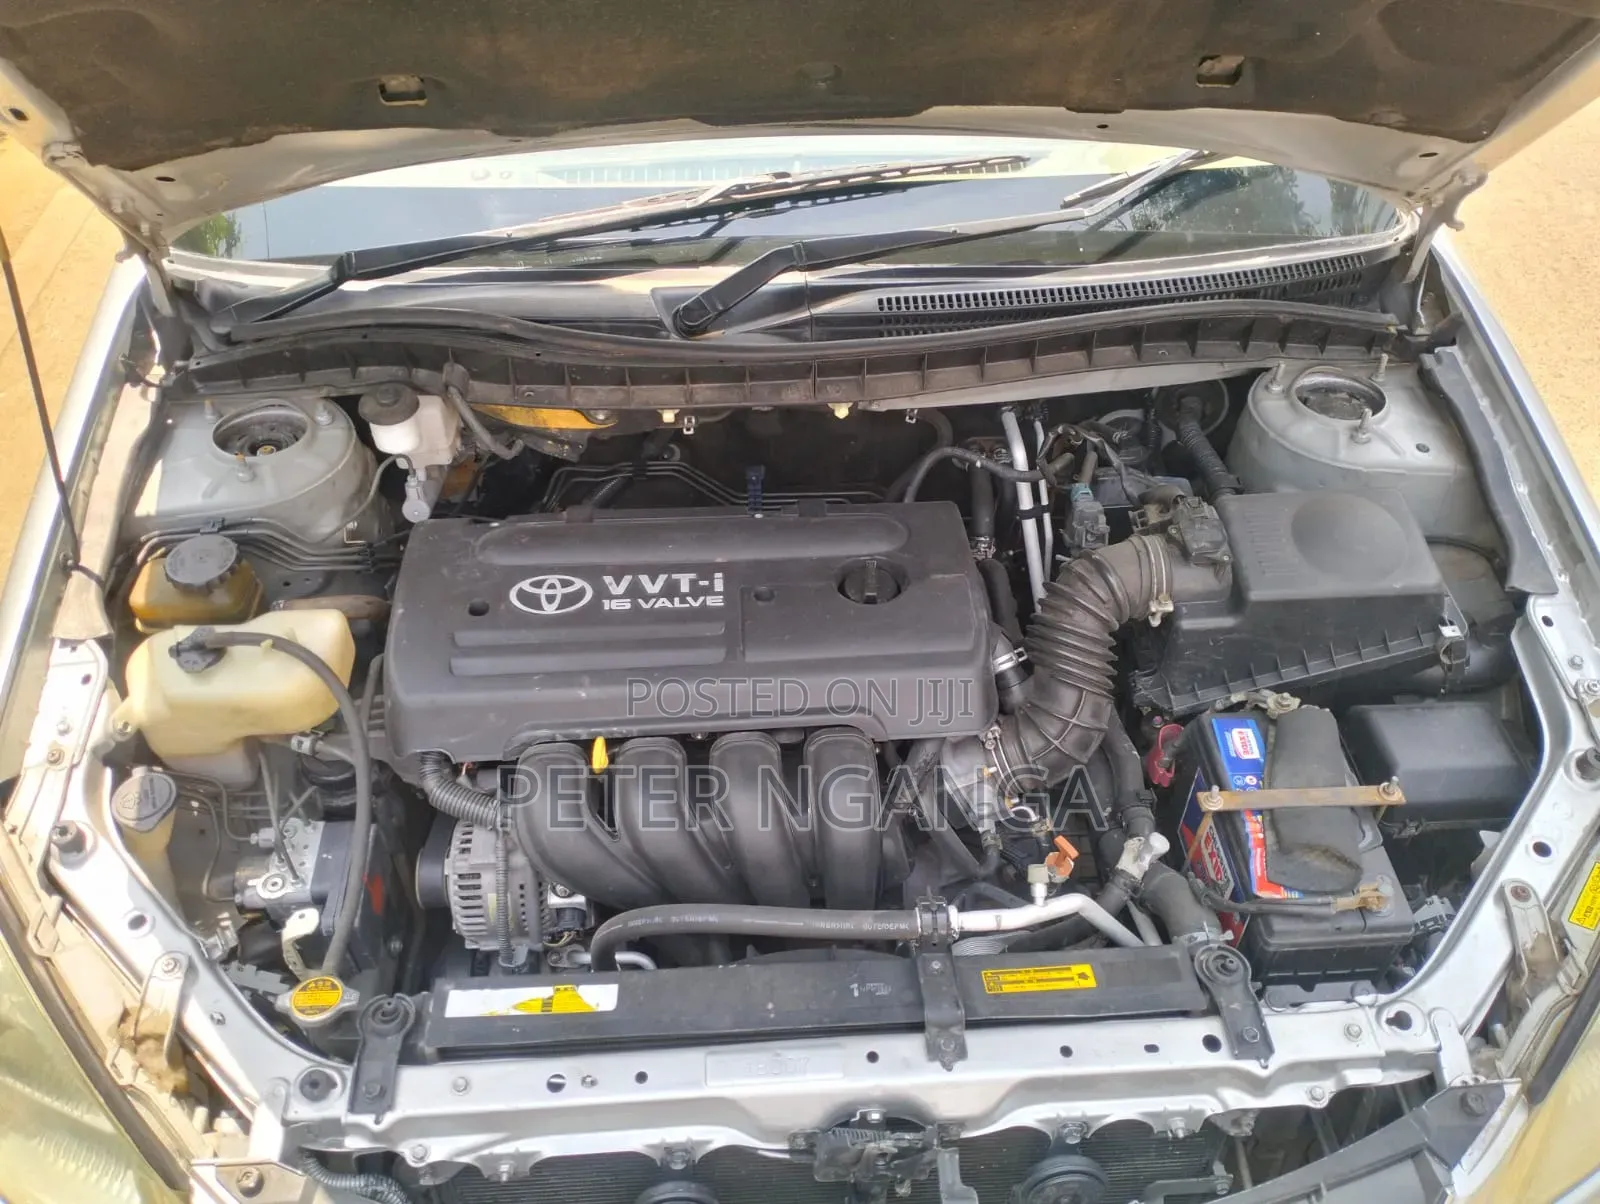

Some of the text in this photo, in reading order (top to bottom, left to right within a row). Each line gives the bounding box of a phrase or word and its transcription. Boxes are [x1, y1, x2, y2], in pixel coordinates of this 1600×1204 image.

[603, 572, 724, 595] VVT-i
[602, 595, 725, 610] 16 VALVE
